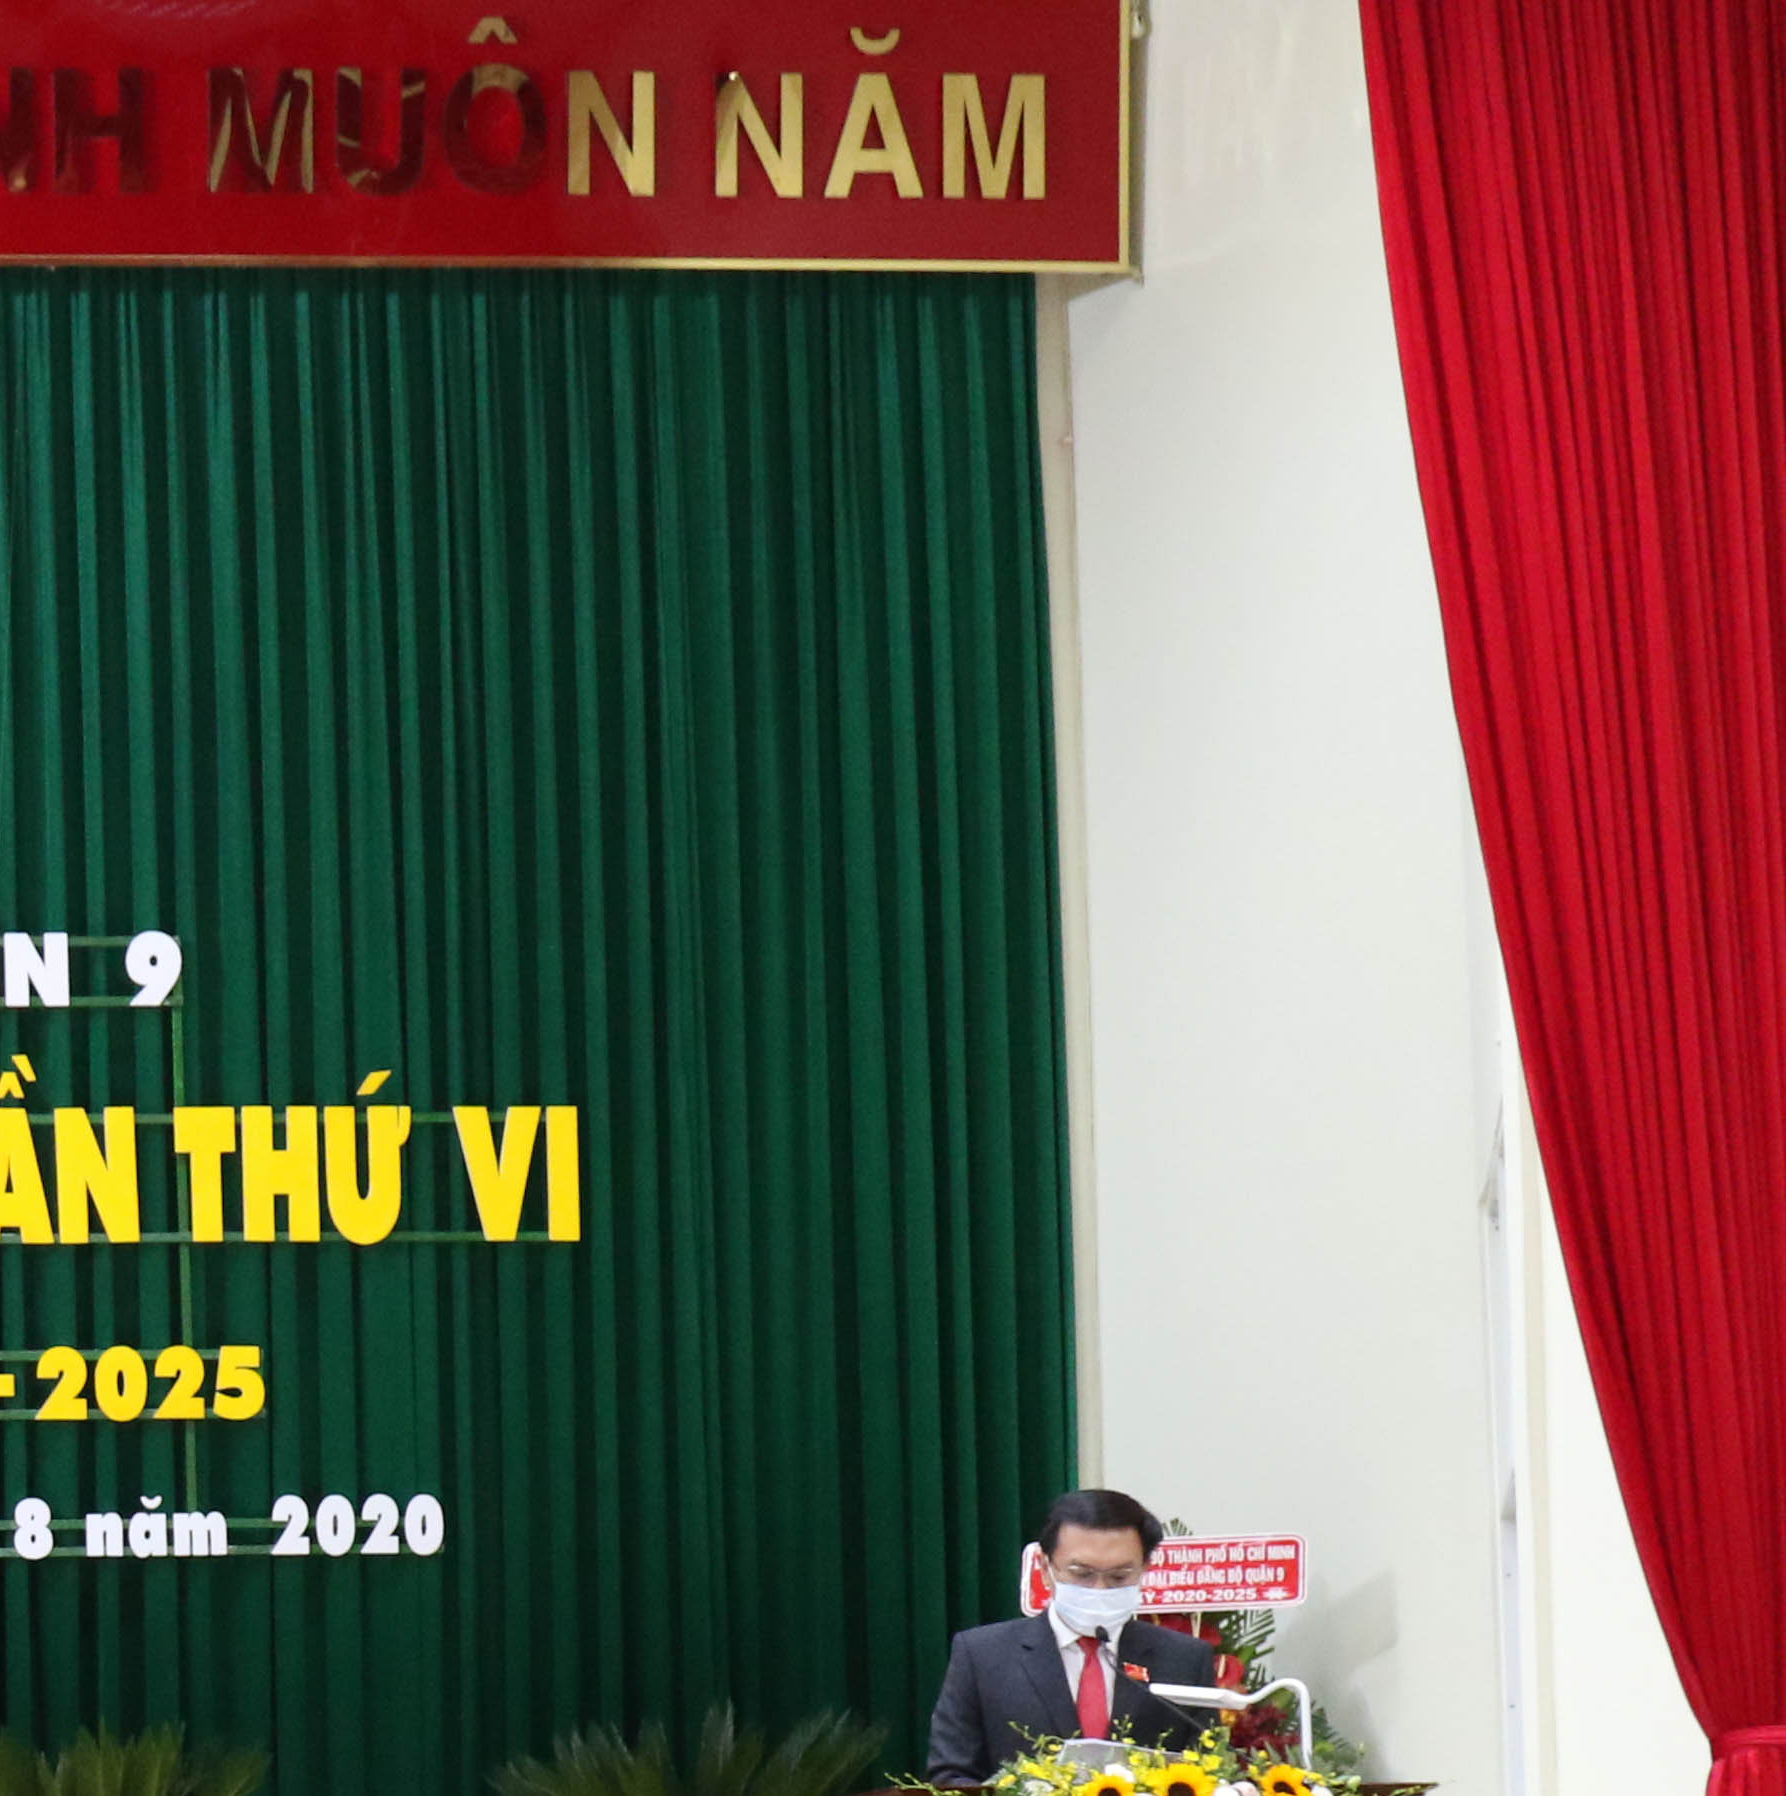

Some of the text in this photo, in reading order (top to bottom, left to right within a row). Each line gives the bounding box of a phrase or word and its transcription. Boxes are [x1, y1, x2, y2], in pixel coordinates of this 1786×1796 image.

[207, 14, 657, 199] MUÔN
[713, 26, 1048, 200] NĂM
[125, 930, 183, 1008] 9
[172, 1070, 412, 1246] THỨ
[455, 1105, 581, 1243] VI
[36, 1345, 266, 1422] 2025
[13, 1497, 54, 1560] 8
[85, 1495, 228, 1559] năm
[270, 1493, 446, 1557] 2020
[1168, 1545, 1203, 1565] THÀNH
[1205, 1544, 1227, 1563] PHỐ
[1247, 1542, 1266, 1561] CHÍ
[1267, 1544, 1296, 1561] MINH
[1245, 1563, 1276, 1585] QUẬN
[1276, 1567, 1285, 1582] 9
